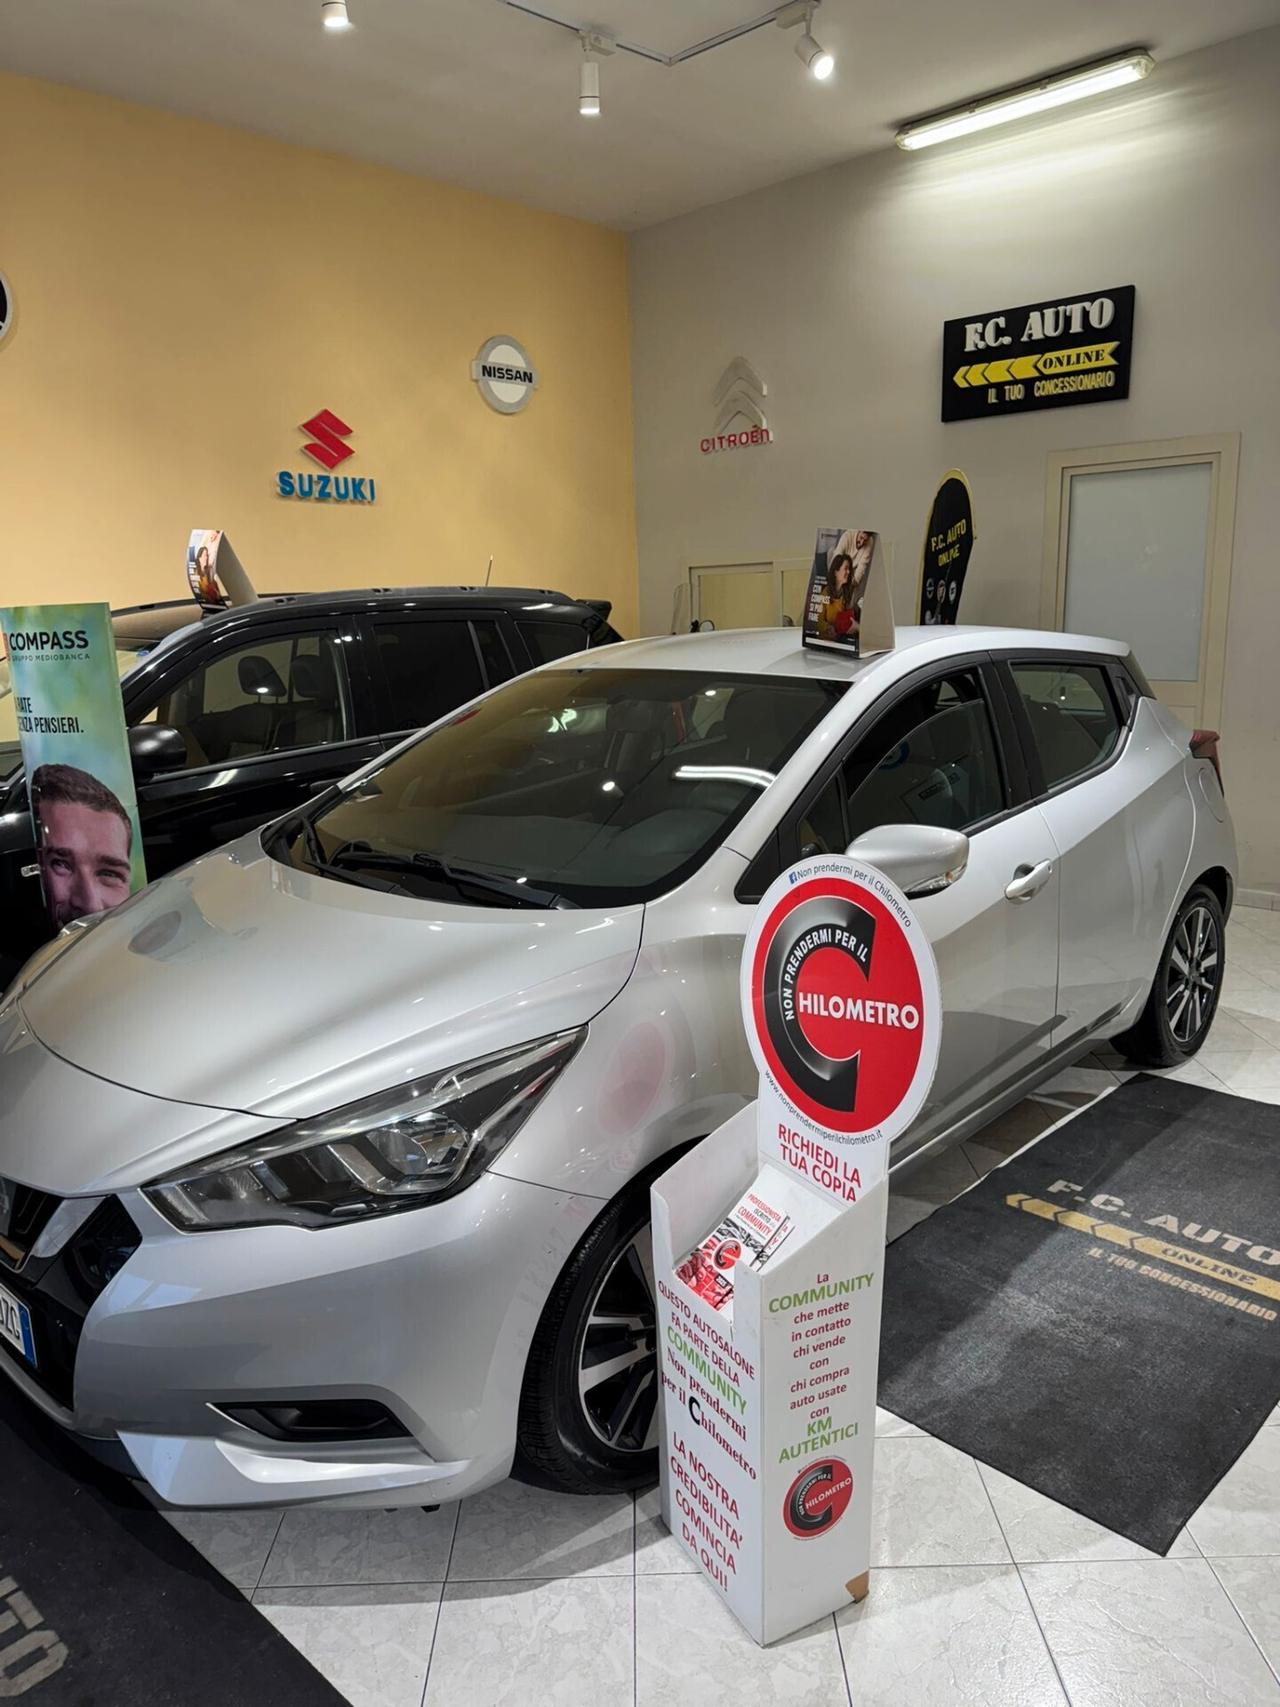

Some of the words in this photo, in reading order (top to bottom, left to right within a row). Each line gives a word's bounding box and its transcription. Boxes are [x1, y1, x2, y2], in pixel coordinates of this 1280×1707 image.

[964, 316, 1012, 352] F.C.
[1020, 297, 1115, 342] AUTO
[481, 365, 533, 383] NISSAN
[1042, 349, 1105, 370] ONLINE
[987, 388, 999, 404] IL
[1004, 384, 1025, 401] TUO
[1034, 370, 1115, 398] CONCESSIONARIO
[277, 471, 376, 503] SUZUKI
[947, 519, 967, 545] AUTO
[938, 544, 961, 567] ONLINE
[9, 630, 89, 651] COMPASS
[35, 653, 90, 662] MEDIOBANCA
[34, 717, 84, 733] PENSIERI.
[796, 867, 812, 879] Non
[813, 862, 853, 875] prendermi
[853, 869, 868, 881] per
[868, 876, 874, 886] il
[874, 880, 911, 928] Chilometro
[784, 928, 832, 984] PRENDERMI
[835, 929, 857, 952] PER
[857, 943, 869, 963] IL
[783, 987, 795, 1021] NON
[779, 1123, 839, 1173] RICHIEDI
[843, 1161, 862, 1189] LA
[780, 1143, 809, 1175] TUA
[812, 1164, 856, 1202] COPIA
[738, 1206, 773, 1236] COMMUNITY
[1144, 1214, 1280, 1266] AUTO
[816, 1273, 830, 1284] La
[1161, 1247, 1260, 1286] ONLINE
[768, 1272, 874, 1313] COMMUNITY
[1088, 1247, 1104, 1259] IL
[1107, 1253, 1138, 1270] TUO
[1139, 1265, 1278, 1321] CONCESSIONARIO
[791, 1331, 802, 1342] in
[805, 1318, 851, 1338] contatto
[793, 1312, 814, 1325] che
[816, 1302, 850, 1318] mette
[658, 1280, 691, 1319] QUESTO
[693, 1314, 755, 1381] AUTOSALONE
[793, 1344, 809, 1359] chi
[812, 1335, 846, 1353] vende
[671, 1312, 682, 1332] FA
[683, 1323, 710, 1358] PARTE
[711, 1350, 740, 1387] DELLA
[809, 1357, 830, 1370] con
[667, 1325, 747, 1415] COMMUNITY
[790, 1379, 807, 1393] chi
[809, 1367, 850, 1387] compra
[667, 1346, 687, 1378] Non
[689, 1375, 747, 1442] prendermi
[790, 1394, 815, 1410] auto
[818, 1384, 847, 1400] usate
[661, 1370, 677, 1393] per
[679, 1387, 686, 1406] il
[688, 1395, 757, 1480] Chilometro
[807, 1416, 832, 1437] KM
[810, 1406, 830, 1419] con
[779, 1422, 859, 1464] AUTENTICI
[673, 1431, 687, 1460] LA
[689, 1450, 740, 1520] NOSTRA
[675, 1489, 737, 1575] COMINCIA
[682, 1522, 698, 1555] DA
[701, 1548, 728, 1593] QUI!
